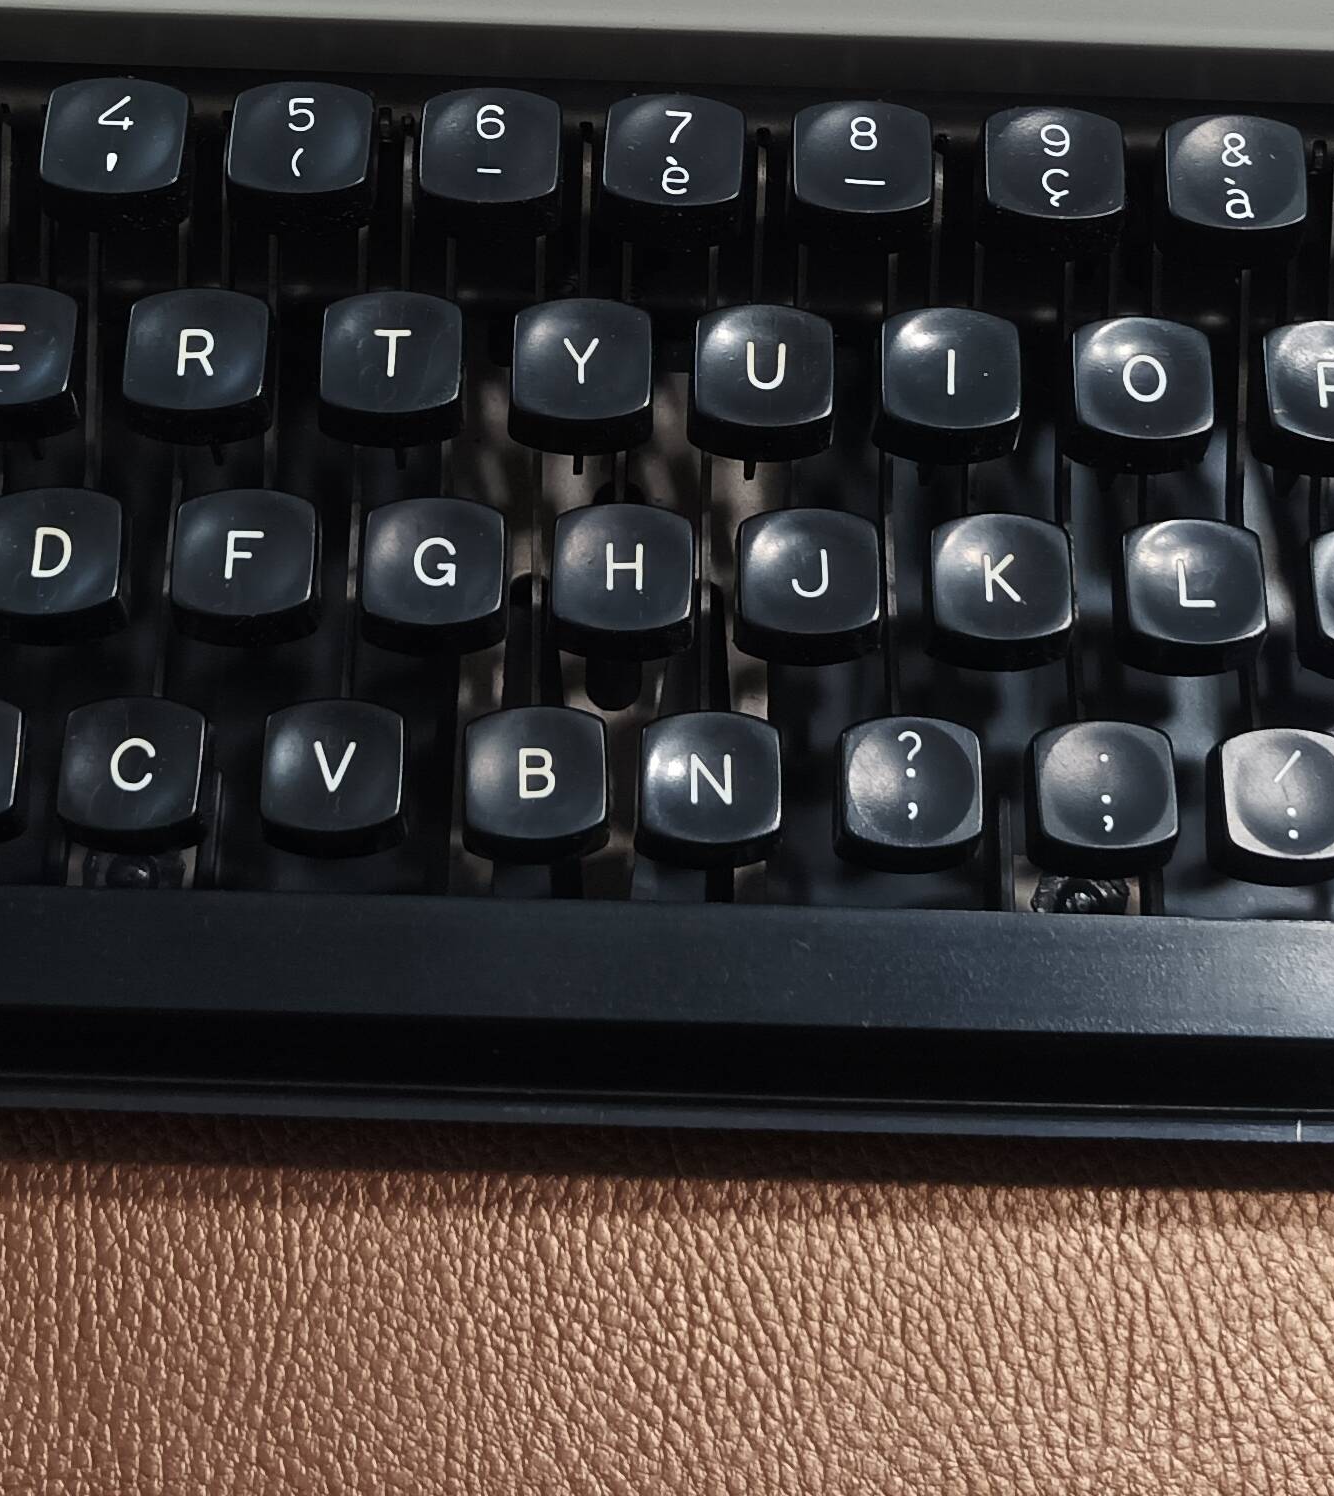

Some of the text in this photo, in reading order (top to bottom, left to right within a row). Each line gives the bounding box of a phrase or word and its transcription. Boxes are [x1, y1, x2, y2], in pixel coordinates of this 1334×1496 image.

[97, 95, 134, 131] 4
[288, 97, 315, 132] 5
[476, 104, 506, 140] 6
[665, 110, 693, 144] 7
[849, 116, 878, 151] 8
[291, 147, 304, 177] (
[1039, 123, 1071, 158] 9
[1221, 131, 1253, 168] &
[661, 155, 690, 195] è
[1041, 168, 1070, 208] ç
[1223, 177, 1255, 219] à
[176, 328, 215, 377] R
[374, 329, 412, 378] T
[563, 337, 600, 384] Y
[745, 340, 787, 391] U
[947, 348, 956, 396] I
[1122, 354, 1167, 403] O
[30, 526, 72, 578] D
[224, 530, 265, 580] F
[413, 537, 457, 587] G
[605, 542, 644, 591] H
[791, 548, 829, 598] J
[982, 552, 1022, 603] K
[1175, 558, 1216, 609] L
[110, 737, 156, 792] C
[313, 740, 357, 792] V
[518, 747, 556, 799] B
[689, 752, 734, 805] N
[897, 730, 923, 779] ?
